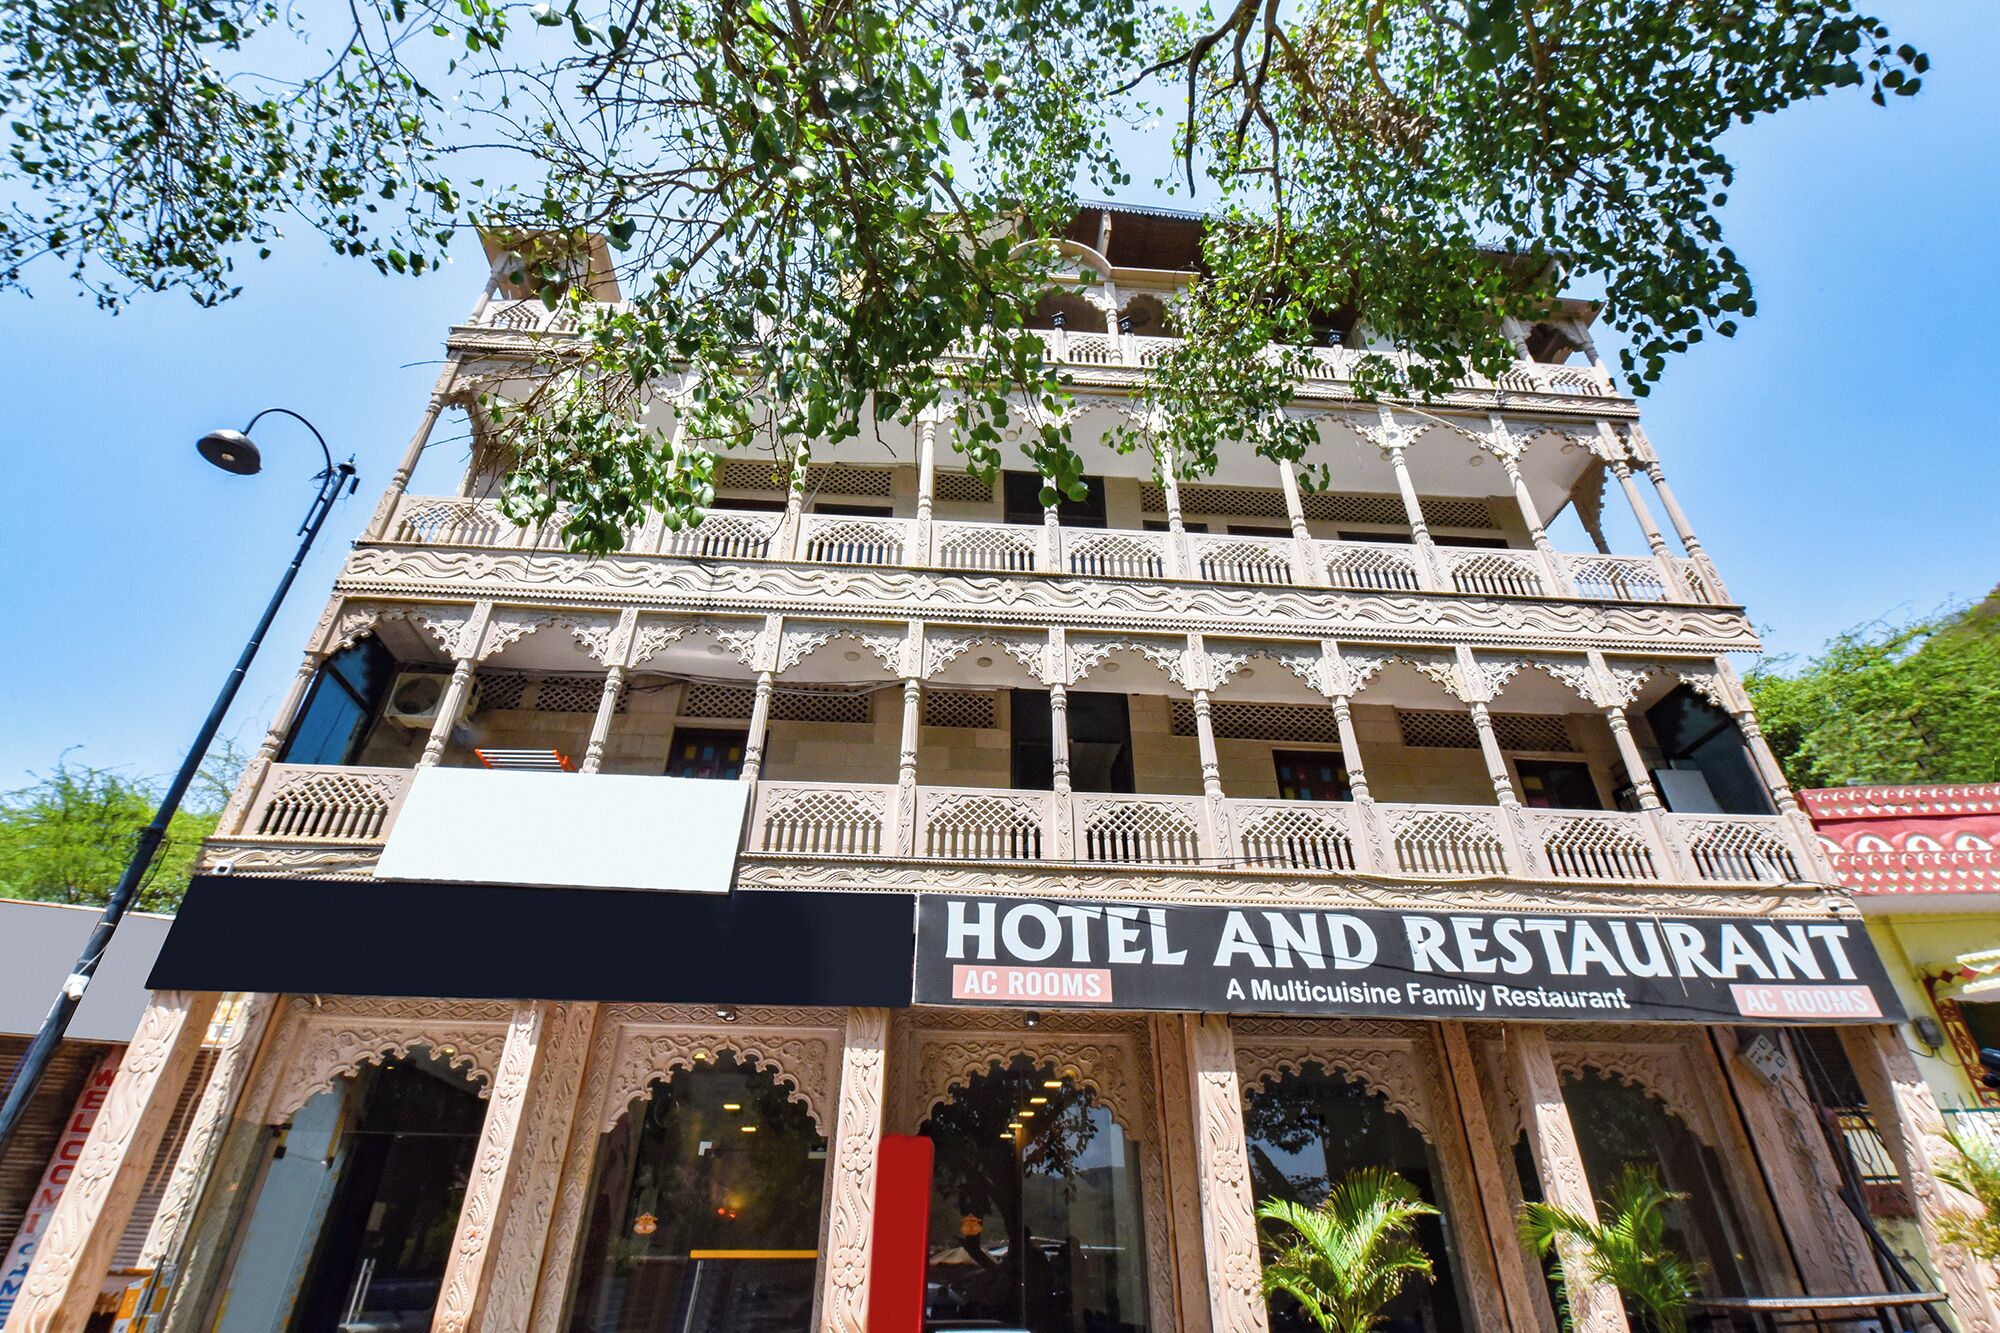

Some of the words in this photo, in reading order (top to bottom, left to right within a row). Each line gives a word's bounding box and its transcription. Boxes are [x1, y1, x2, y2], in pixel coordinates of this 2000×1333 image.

[945, 900, 1189, 966] HOTEL
[1213, 910, 1379, 971] AND
[1402, 915, 1859, 981] RESTAURANT
[963, 970, 998, 995] AC
[1007, 971, 1102, 998] ROOMS
[1226, 978, 1246, 1001] A
[1251, 979, 1402, 1005] Multicuisine
[1407, 982, 1486, 1012] Family
[1494, 985, 1631, 1010] Restaurant
[1744, 988, 1777, 1013] AC
[1783, 990, 1869, 1014] ROOMS
